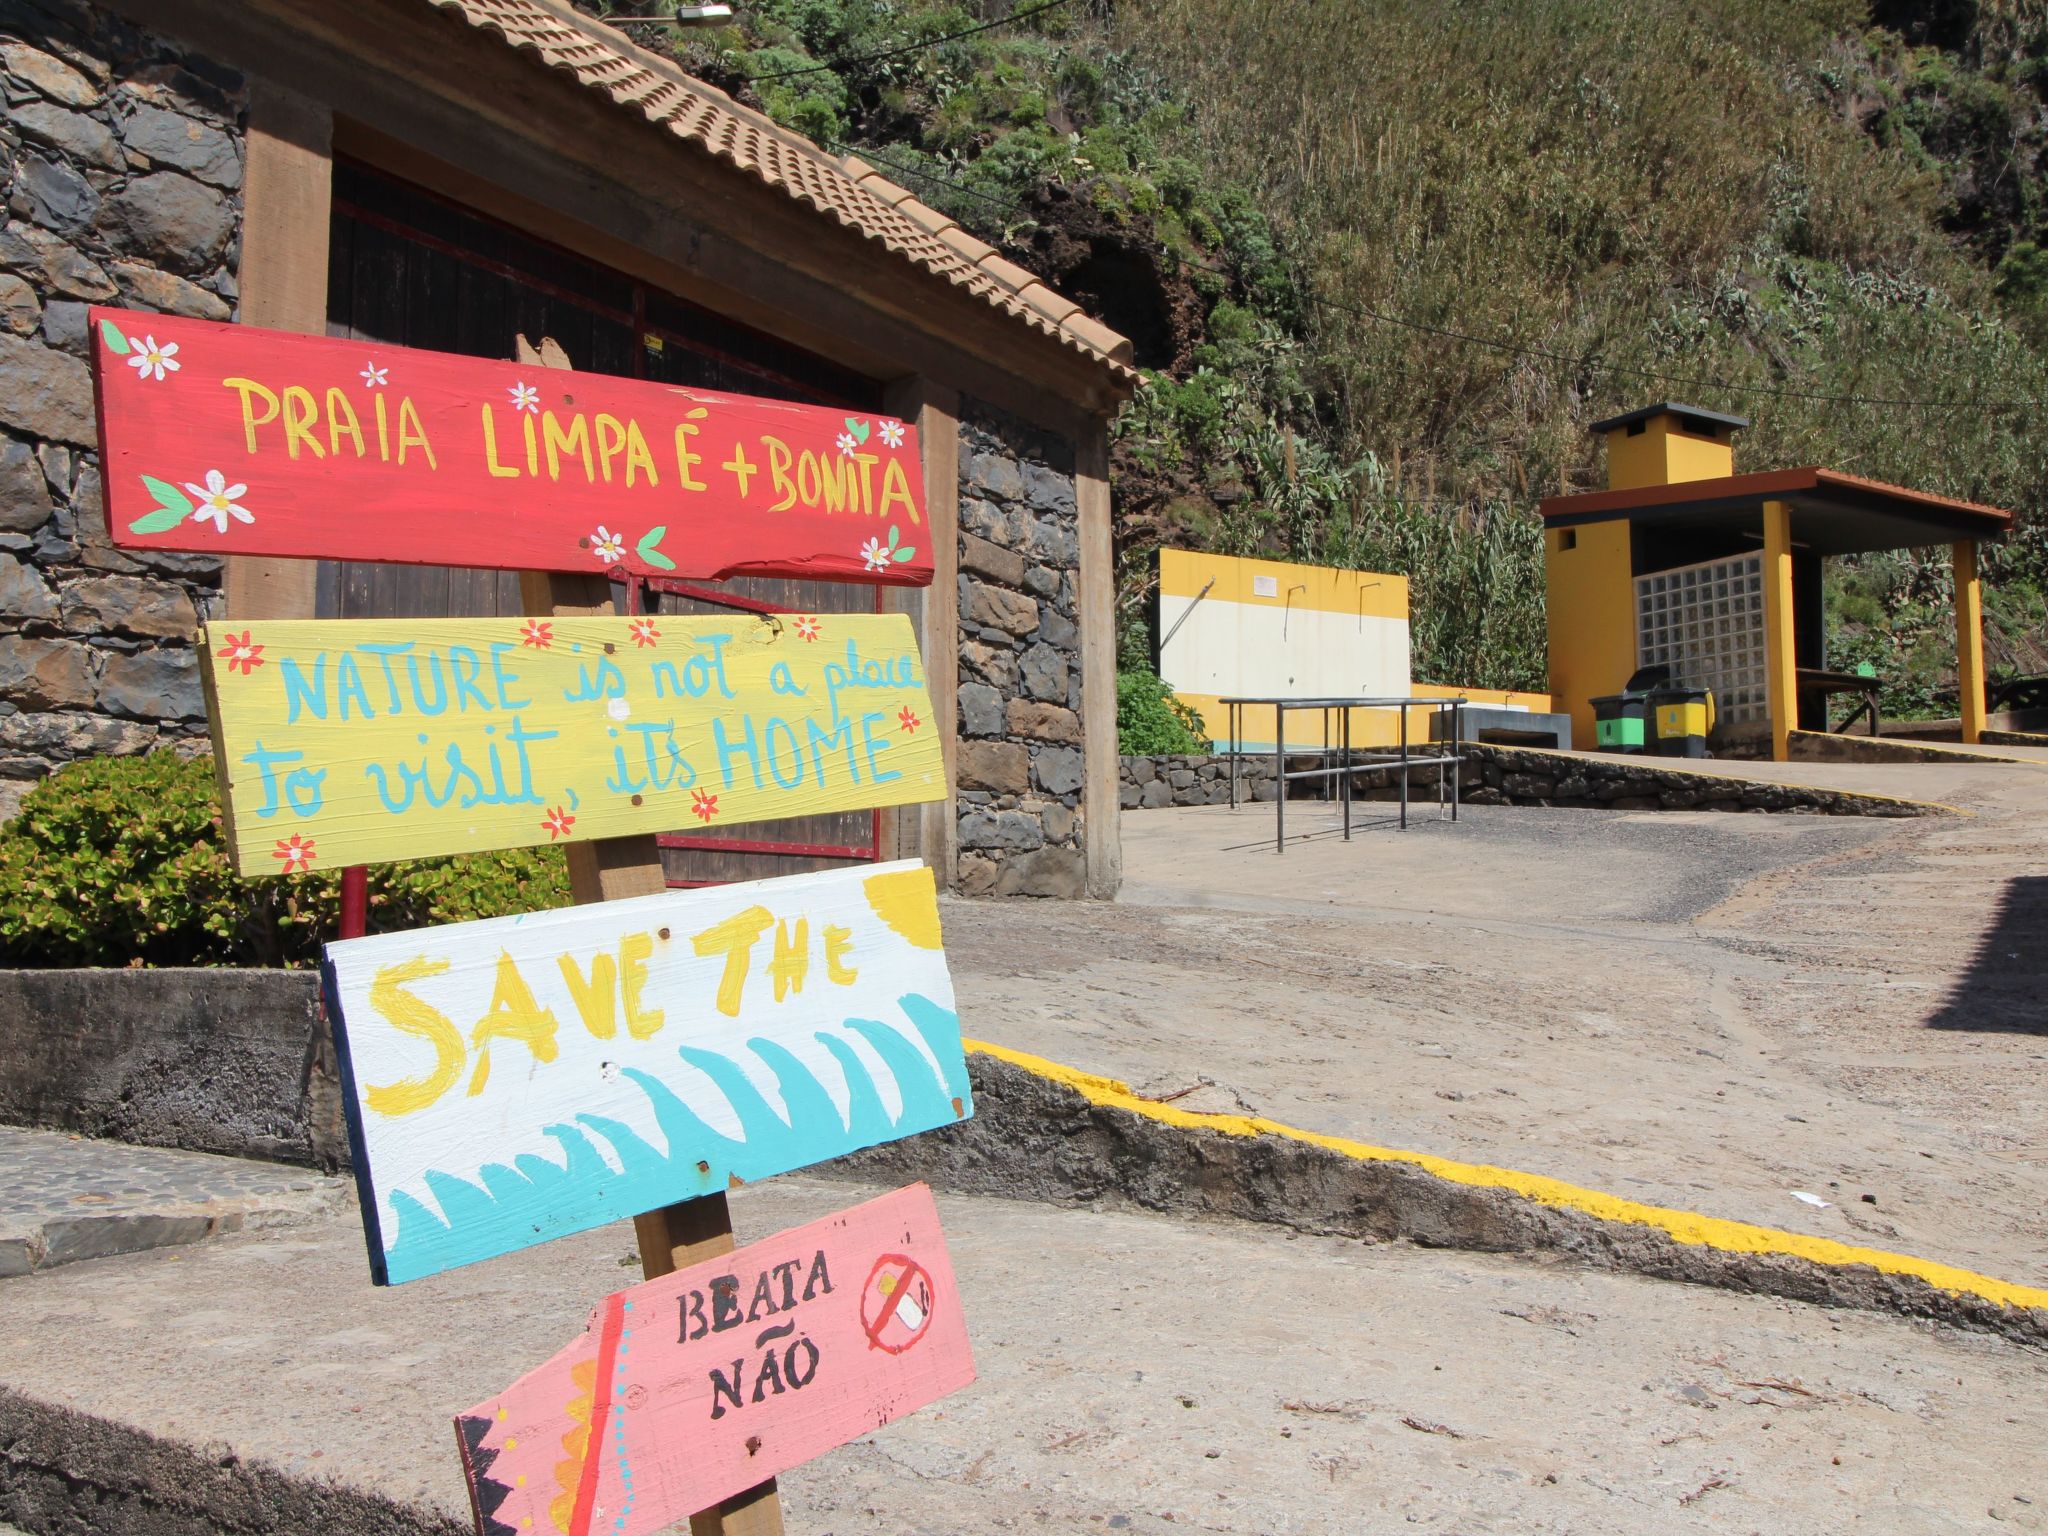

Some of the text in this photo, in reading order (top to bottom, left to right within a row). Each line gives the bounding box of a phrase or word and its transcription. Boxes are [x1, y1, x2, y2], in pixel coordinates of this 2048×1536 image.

[223, 377, 437, 470] PRAIA
[482, 402, 660, 488] LIMPA
[674, 407, 709, 492] É
[280, 633, 925, 726] NATURE is not a place
[241, 739, 328, 818] to
[712, 712, 903, 791] HOME
[364, 904, 858, 1118] SAVE THE
[676, 1249, 836, 1344] BEATA
[709, 1317, 820, 1420] NÃO
